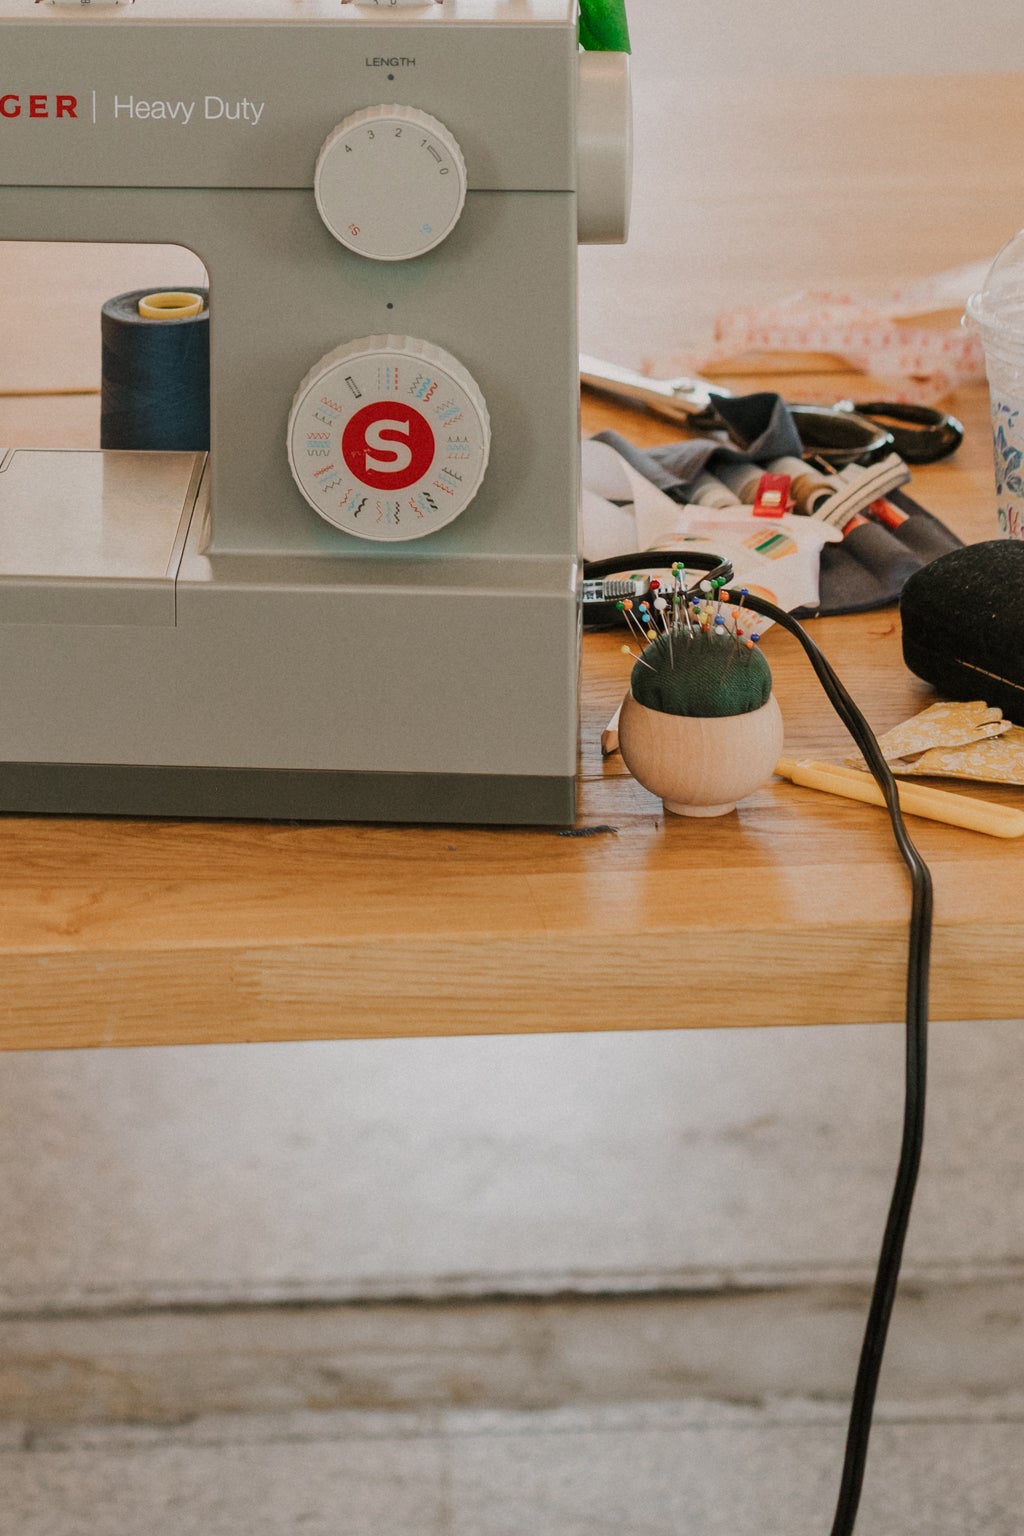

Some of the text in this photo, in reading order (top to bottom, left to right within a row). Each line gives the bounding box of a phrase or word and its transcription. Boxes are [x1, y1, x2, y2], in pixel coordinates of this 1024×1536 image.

[365, 57, 417, 67] LENGTH
[114, 95, 196, 126] Heavy
[204, 96, 266, 125] Duty
[344, 128, 450, 176] 4 3 2 1 0
[364, 418, 413, 474] S
